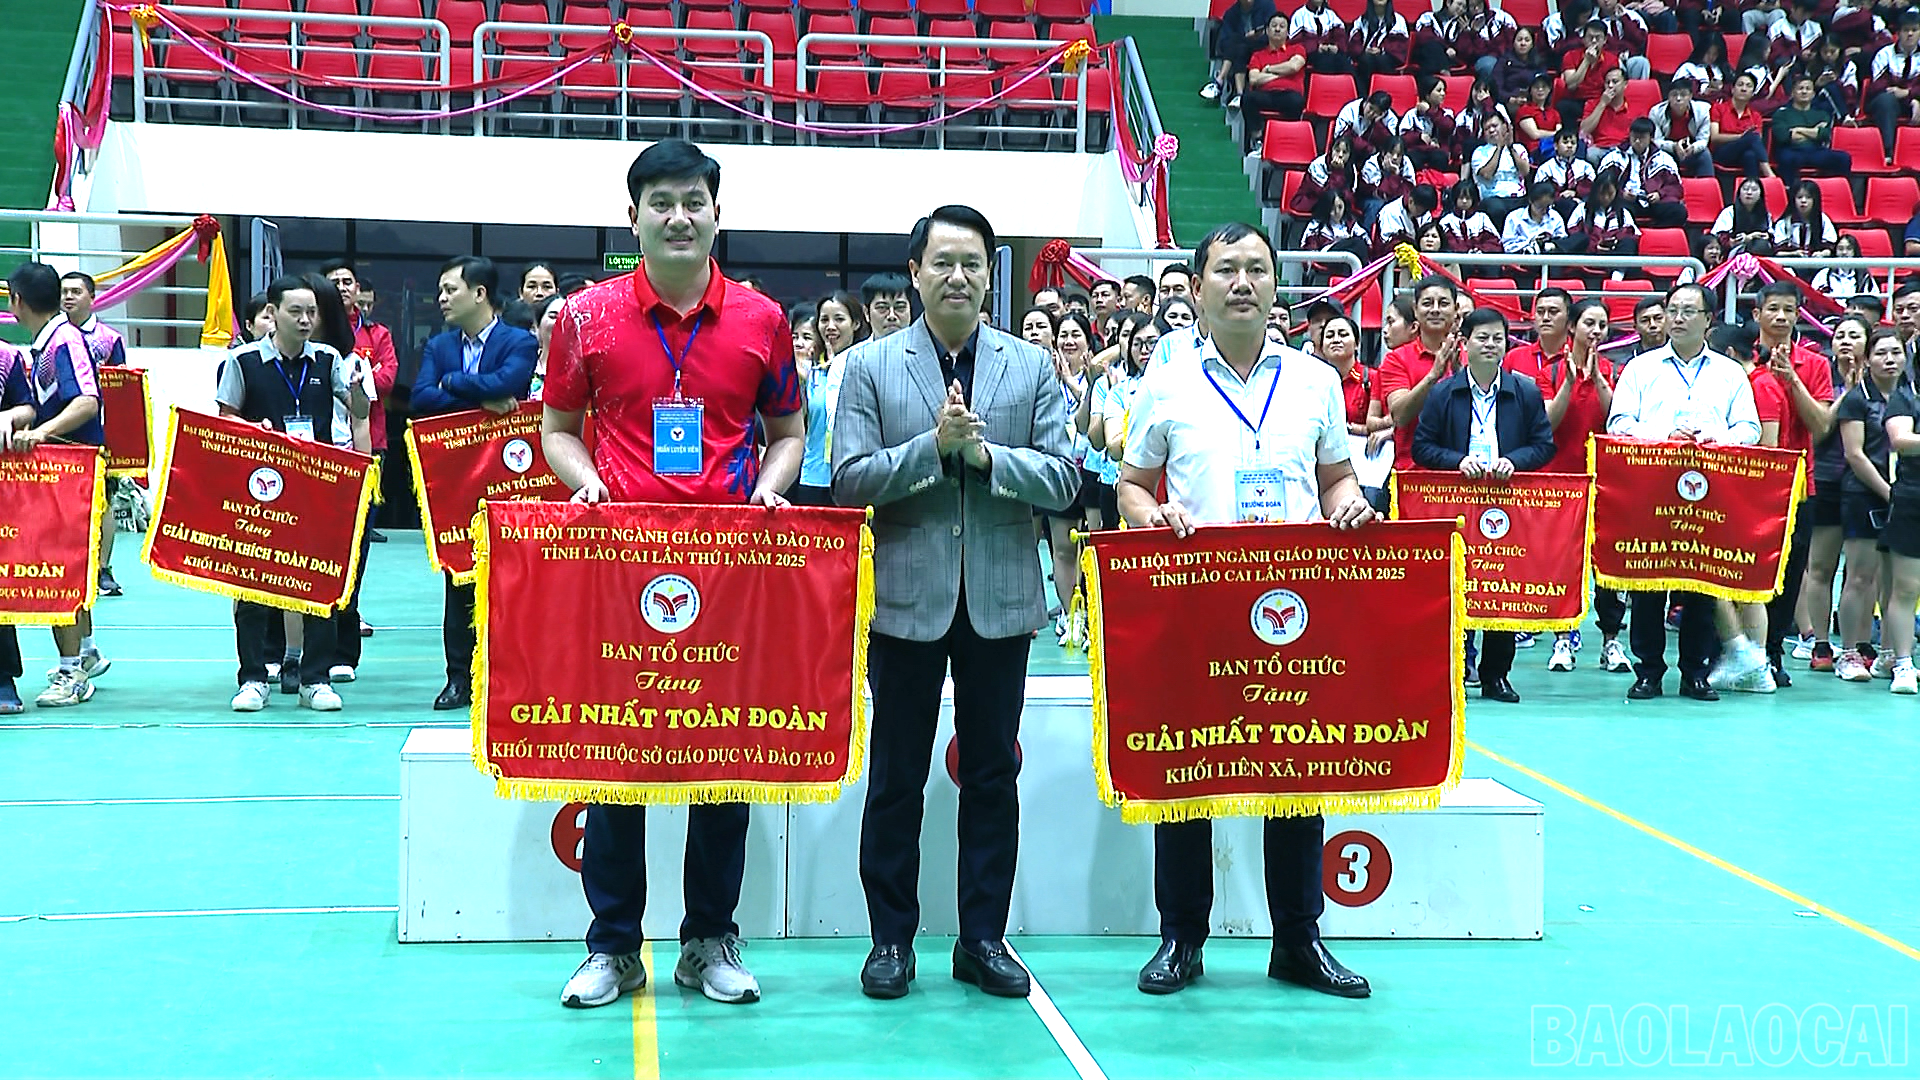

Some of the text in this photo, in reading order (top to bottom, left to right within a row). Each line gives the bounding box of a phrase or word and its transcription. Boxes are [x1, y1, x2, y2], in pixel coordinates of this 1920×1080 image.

[487, 482, 511, 495] BAN
[222, 500, 244, 514] BAN
[262, 509, 299, 526] CHỨC
[162, 522, 190, 541] GIẢI
[234, 541, 273, 561] KHÍCH
[274, 550, 309, 570] TOÀN
[309, 558, 343, 578] ĐOÀN
[500, 524, 845, 552] ĐẠI HỘI TDTT NGÀNH GIÁO DỤC VÀ ĐÀO TẠO
[541, 543, 806, 568] TỈNH LÀO CAI LẦN THỨ I, NĂM 2025
[1110, 545, 1444, 573] ĐẠI HỘI TDTT NGÀNH GIÁO DỤC VÀ ĐÀO TẠO
[1615, 538, 1756, 565] GIẢI BA TOÀN ĐOÀN
[14, 562, 65, 578] ĐOÀN
[183, 555, 213, 570] KHỐI
[261, 572, 312, 592] PHƯỜNG
[1150, 564, 1406, 587] TỈNH LÀO CAI LẦN THỨ I, NĂM 2025
[1465, 578, 1567, 596] HÌ TOÀN ĐOÀN
[601, 638, 740, 663] BAN TỔ CHỨC
[1208, 651, 1346, 677] BAN TỔ CHỨC
[635, 671, 703, 694] Tặng
[1242, 684, 1310, 706] Tặng
[510, 696, 828, 731] GIẢI NHẤT TOÀN ĐOÀN
[1126, 715, 1429, 752] GIẢI NHẤT TOÀN ĐOÀN
[491, 737, 835, 769] KHỐI TRỰC THUỘC SỞ GIÁO DỤC VÀ ĐÀO TẠO
[1165, 756, 1392, 784] KHỐI LIÊN XÃ, PHƯỜNG
[1337, 843, 1371, 893] 3
